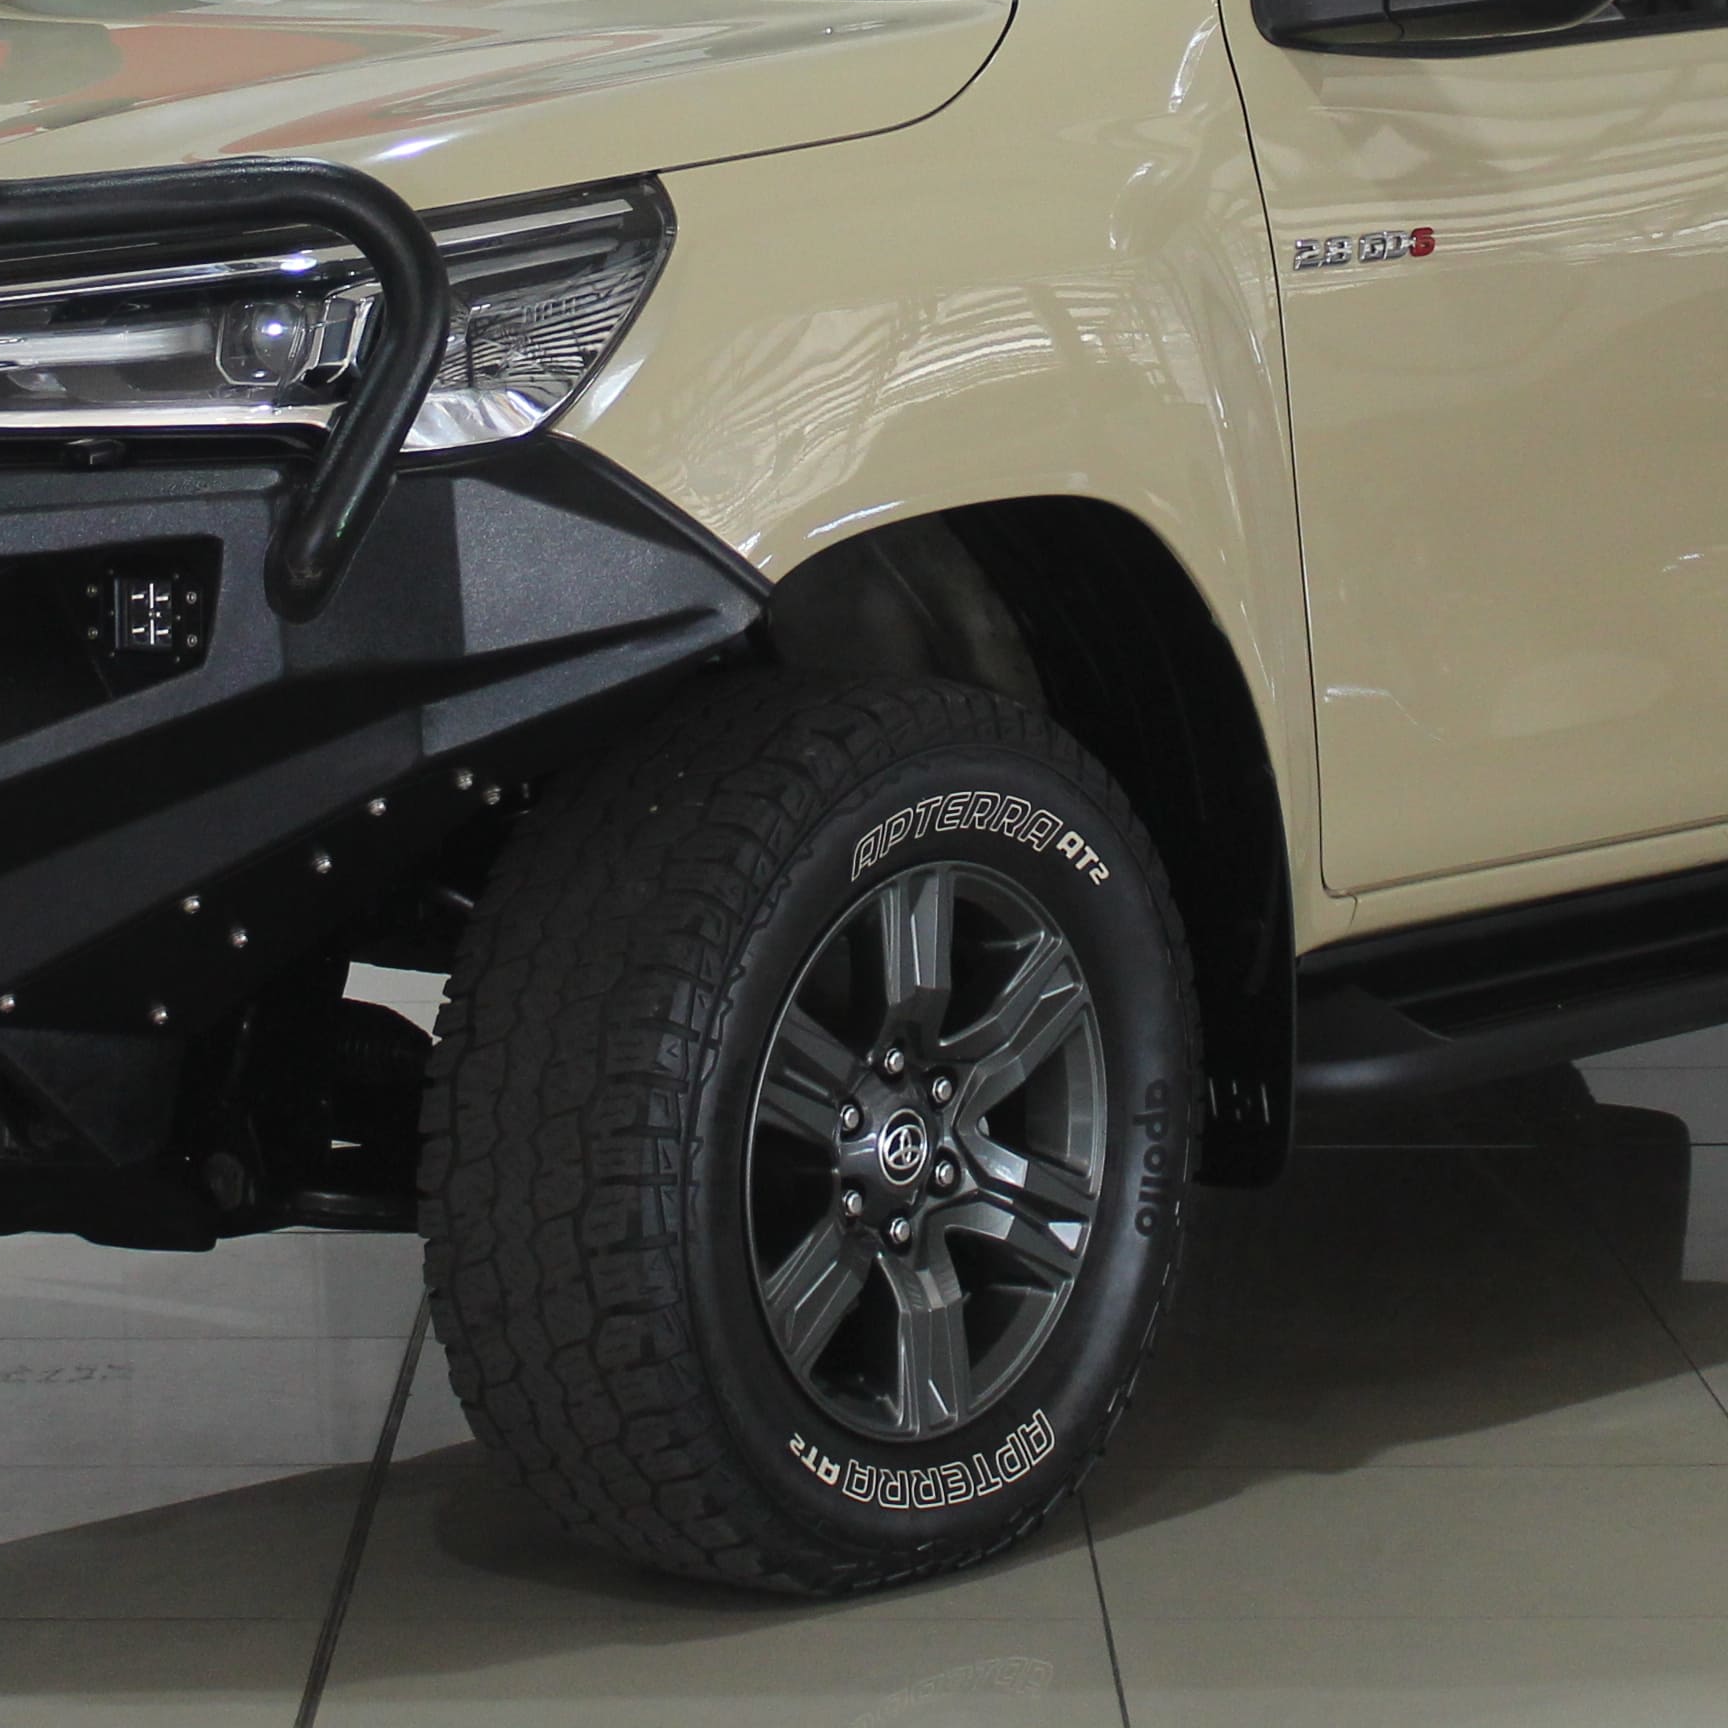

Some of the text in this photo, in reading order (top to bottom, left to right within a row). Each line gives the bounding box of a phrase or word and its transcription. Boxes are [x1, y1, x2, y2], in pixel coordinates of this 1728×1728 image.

[851, 790, 1064, 883] APTERRA
[1133, 1077, 1175, 1239] apollo
[841, 1408, 1057, 1510] APTERRA
